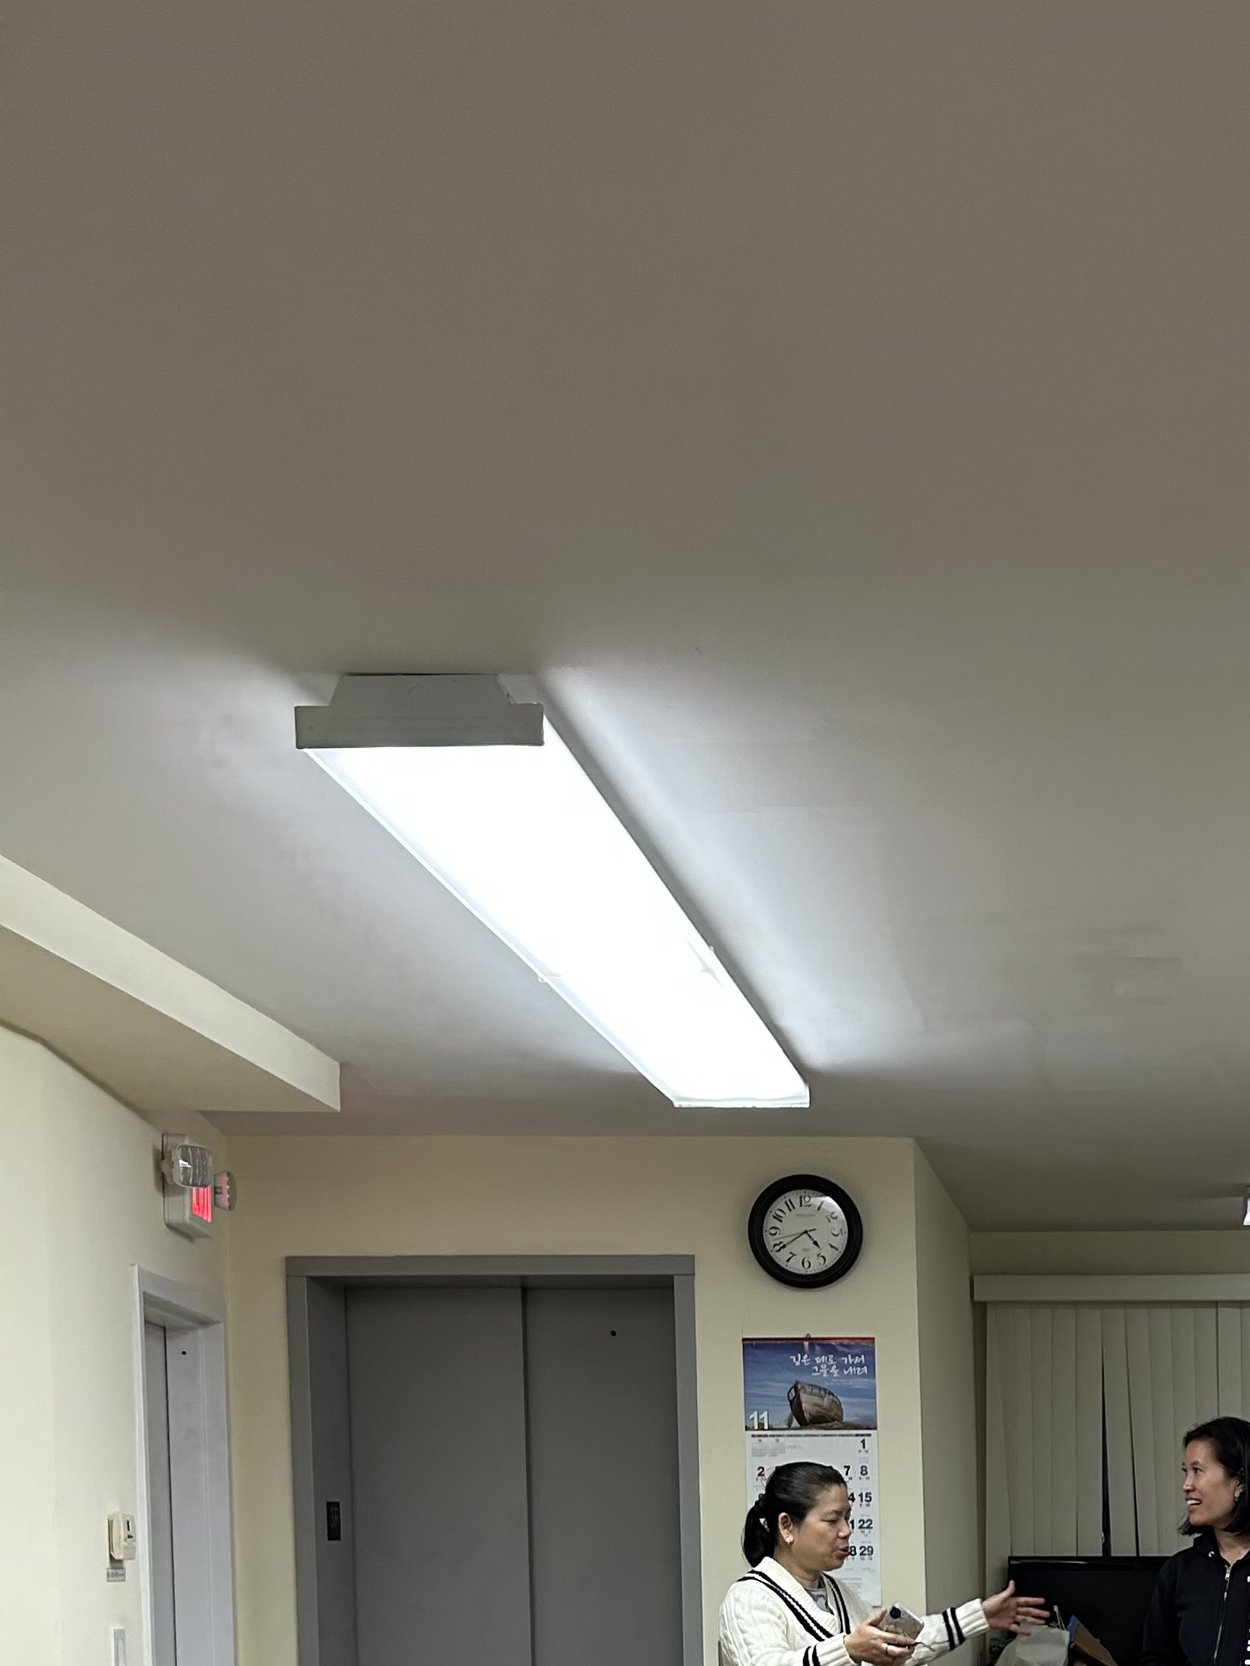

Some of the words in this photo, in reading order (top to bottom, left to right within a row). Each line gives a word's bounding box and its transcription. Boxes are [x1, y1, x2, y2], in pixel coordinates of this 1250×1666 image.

[785, 1198, 796, 1212] 11
[799, 1195, 812, 1207] 12
[772, 1208, 787, 1223] 10
[769, 1226, 781, 1236] 9
[773, 1241, 786, 1252] 8
[786, 1251, 796, 1263] 7
[802, 1257, 811, 1269] 6
[789, 1353, 811, 1366] 깊은
[749, 1410, 768, 1430] 11
[860, 1438, 866, 1449] 1
[757, 1466, 765, 1477] 2
[843, 1465, 851, 1476] 7
[860, 1465, 868, 1476] 8
[848, 1492, 856, 1502] 4
[858, 1492, 872, 1502] 15
[858, 1519, 873, 1529] 22
[859, 1546, 874, 1556] 29
